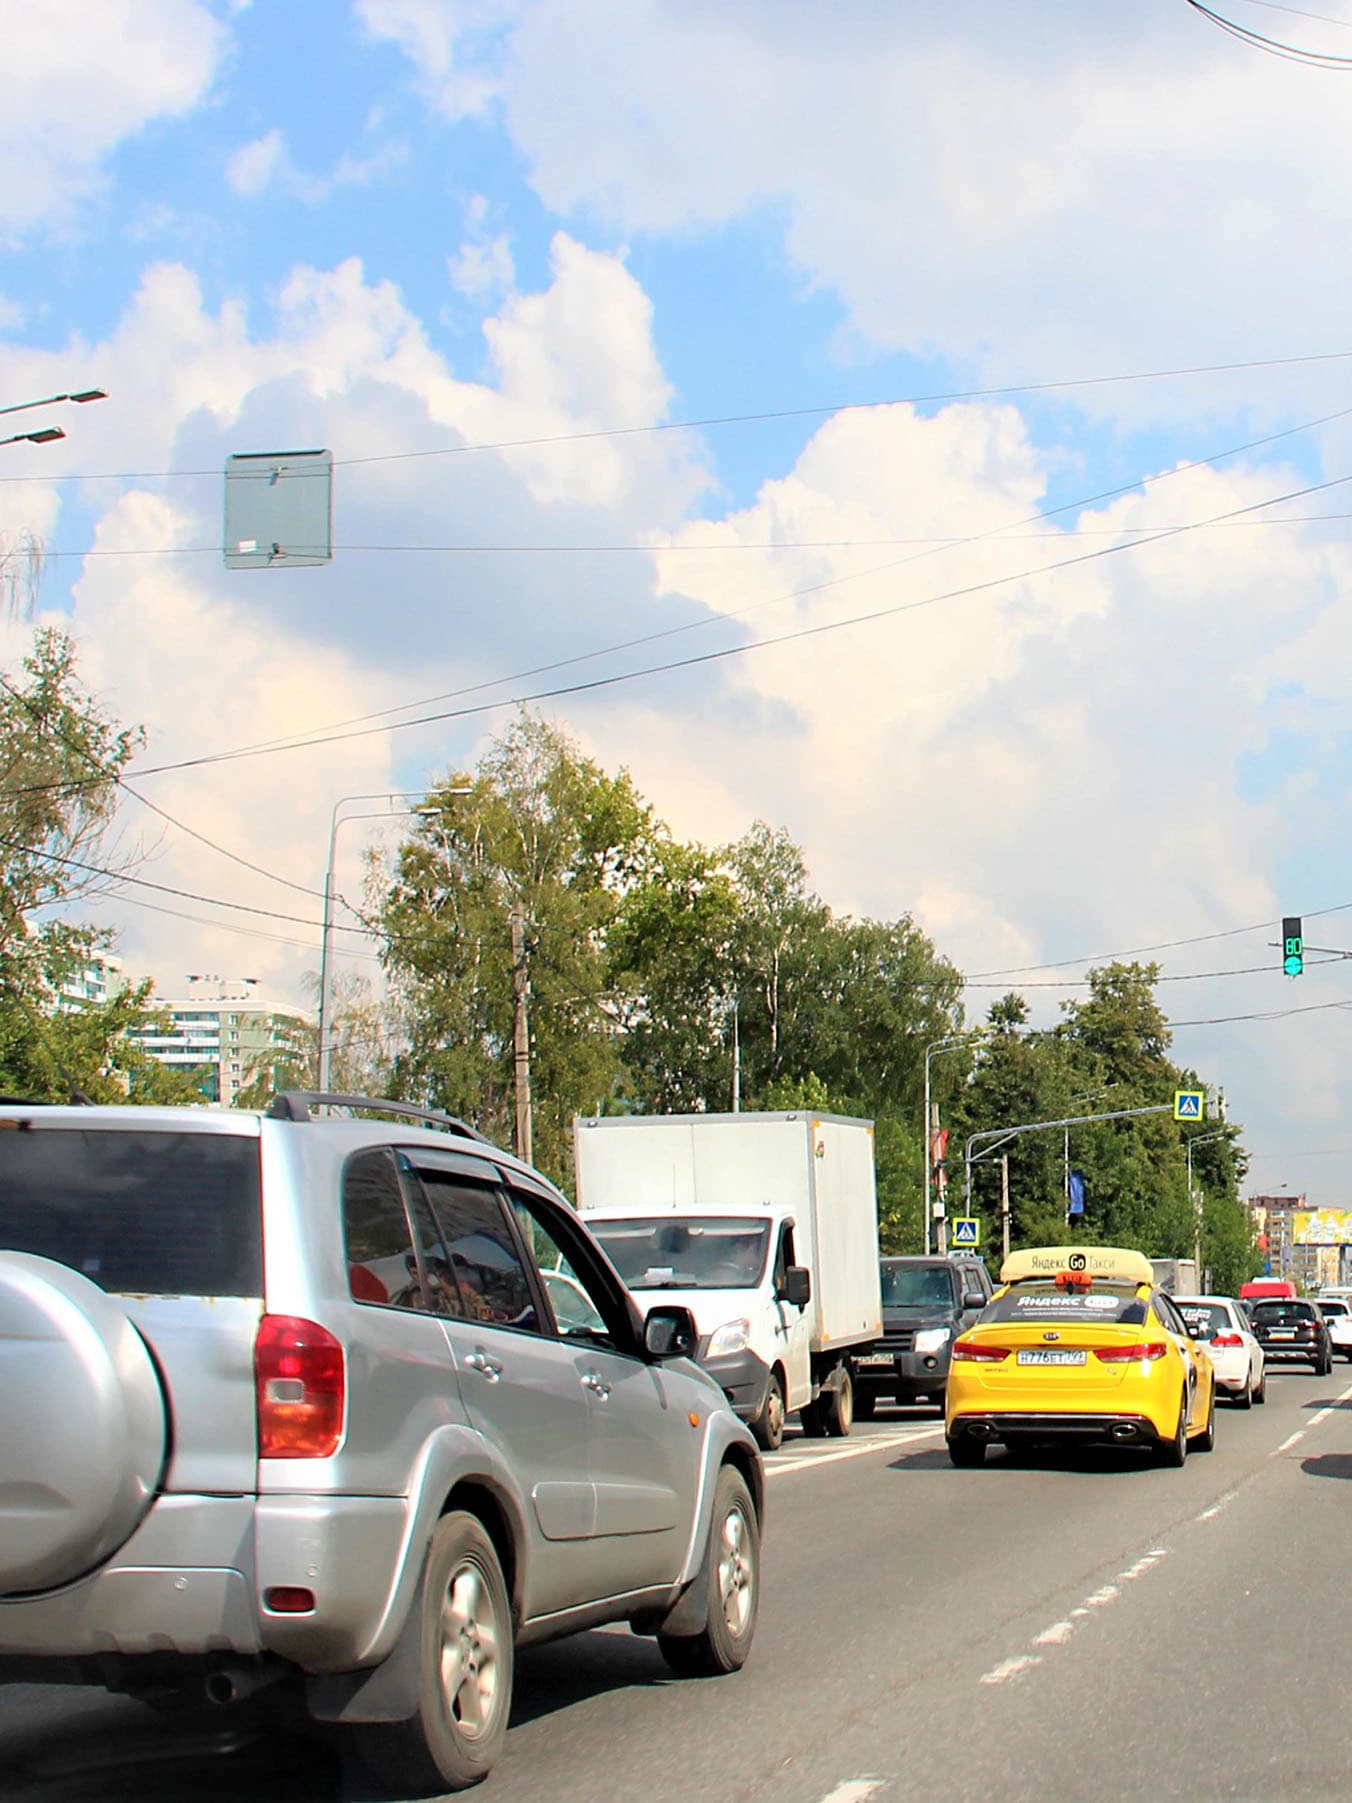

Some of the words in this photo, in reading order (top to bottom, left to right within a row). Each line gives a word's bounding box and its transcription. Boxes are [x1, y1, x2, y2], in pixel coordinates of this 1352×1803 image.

[1286, 937, 1303, 955] 80
[1031, 1256, 1066, 1270] Яндекс
[1070, 1255, 1085, 1270] Go
[1089, 1255, 1116, 1270] Такси
[1017, 1296, 1081, 1307] Яндекс
